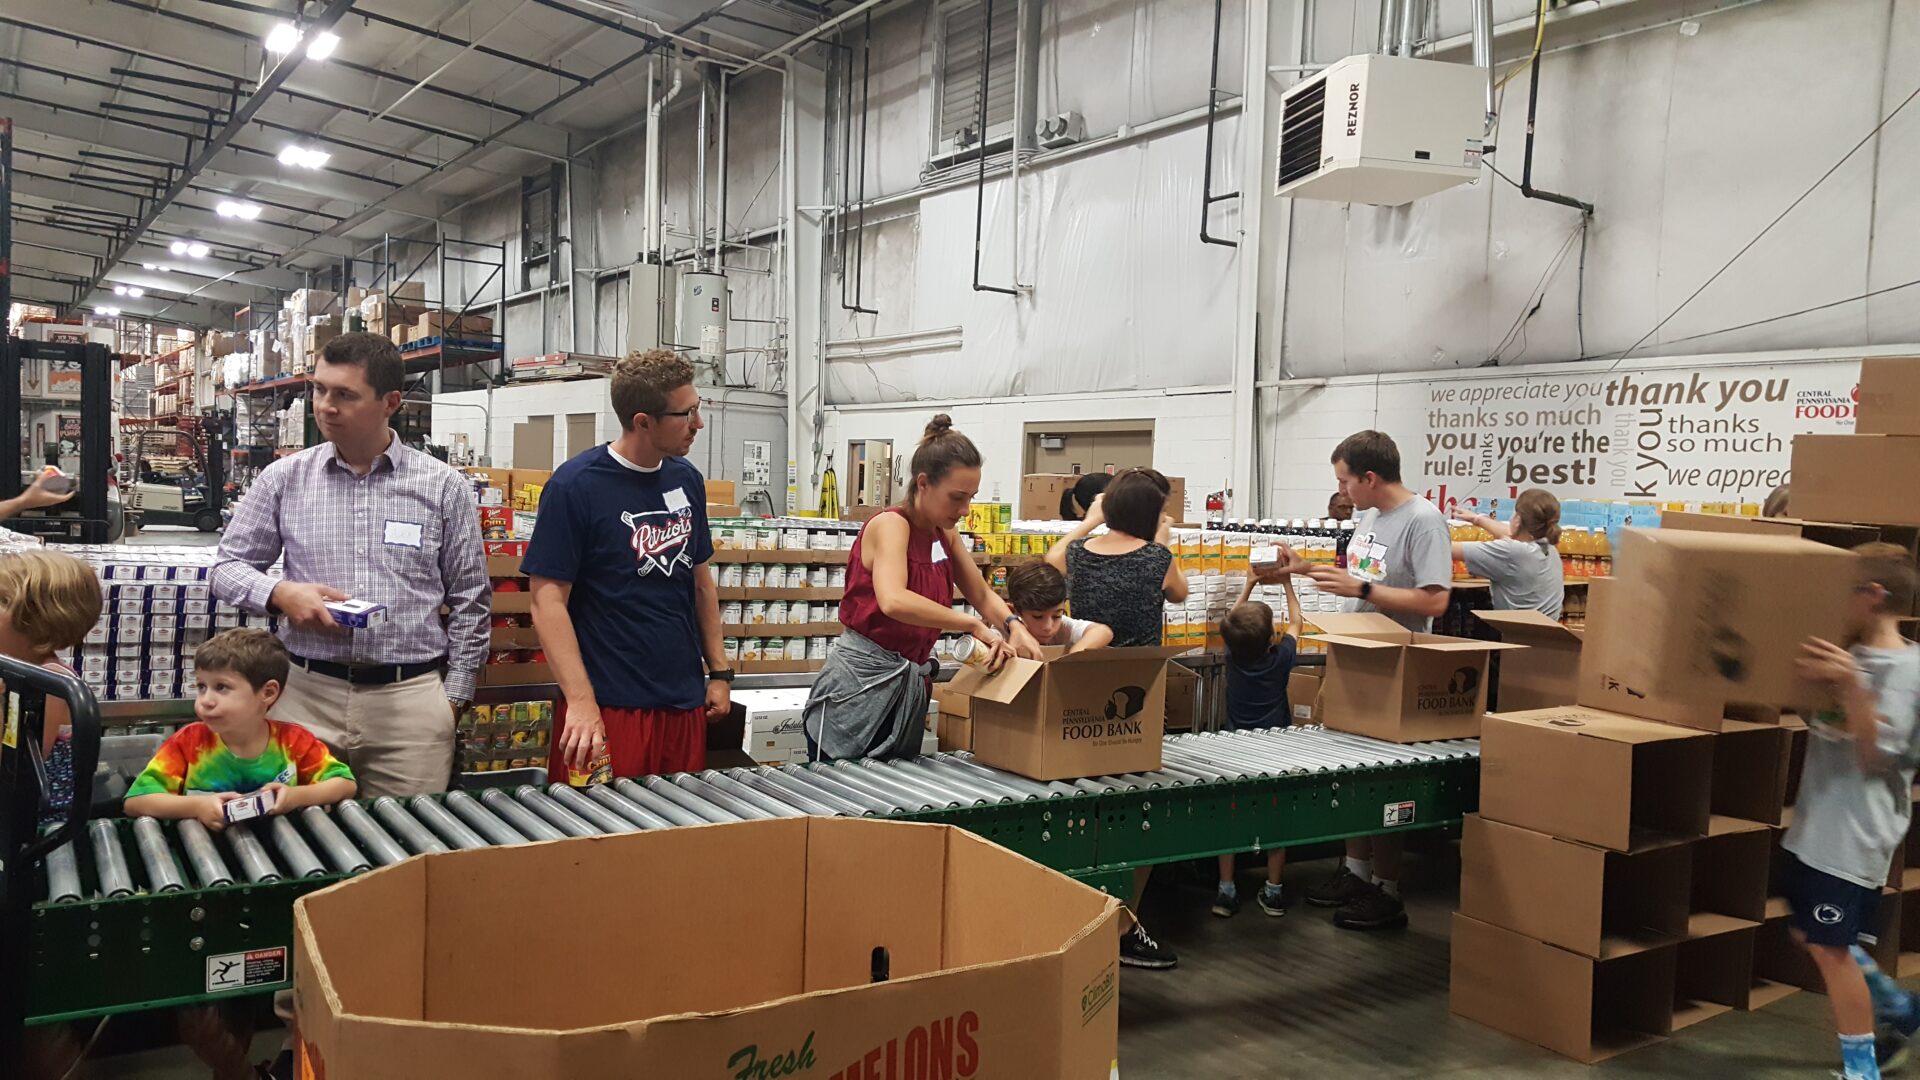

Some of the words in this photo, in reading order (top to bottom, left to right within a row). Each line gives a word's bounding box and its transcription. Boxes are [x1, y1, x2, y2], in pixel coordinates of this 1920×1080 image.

[1347, 82, 1360, 137] REZNOR
[1431, 388, 1455, 402] we
[1459, 381, 1560, 405] appreciate
[1563, 382, 1604, 402] you
[1605, 372, 1710, 407] thank
[1714, 378, 1790, 412] you
[1797, 390, 1831, 398] CENTRAL
[1428, 407, 1498, 428] thanks
[1504, 410, 1529, 426] so
[1536, 403, 1601, 426] much
[1668, 413, 1760, 434] thanks
[1795, 404, 1850, 419] FOOD
[1426, 432, 1477, 456] you
[1497, 430, 1566, 460] you're
[1572, 428, 1610, 453] the
[1613, 412, 1637, 456] thank
[1635, 408, 1669, 471] you
[1666, 437, 1696, 453] so
[1703, 432, 1783, 453] much
[1424, 455, 1475, 476] rule!
[1477, 432, 1494, 484] thanks
[1505, 457, 1598, 485] best!
[1606, 460, 1629, 487] you
[1668, 467, 1701, 486] we
[1063, 708, 1090, 717] CENTRAL
[1417, 697, 1447, 711] FOOD
[1449, 695, 1476, 709] BANK
[1062, 716, 1106, 726] PENNSYLVANIA
[1062, 724, 1103, 741] FOOD
[1107, 721, 1142, 737] BANK
[254, 949, 281, 960] DANGER
[727, 1030, 817, 1080] Fresh
[829, 1010, 979, 1080] ELONS
